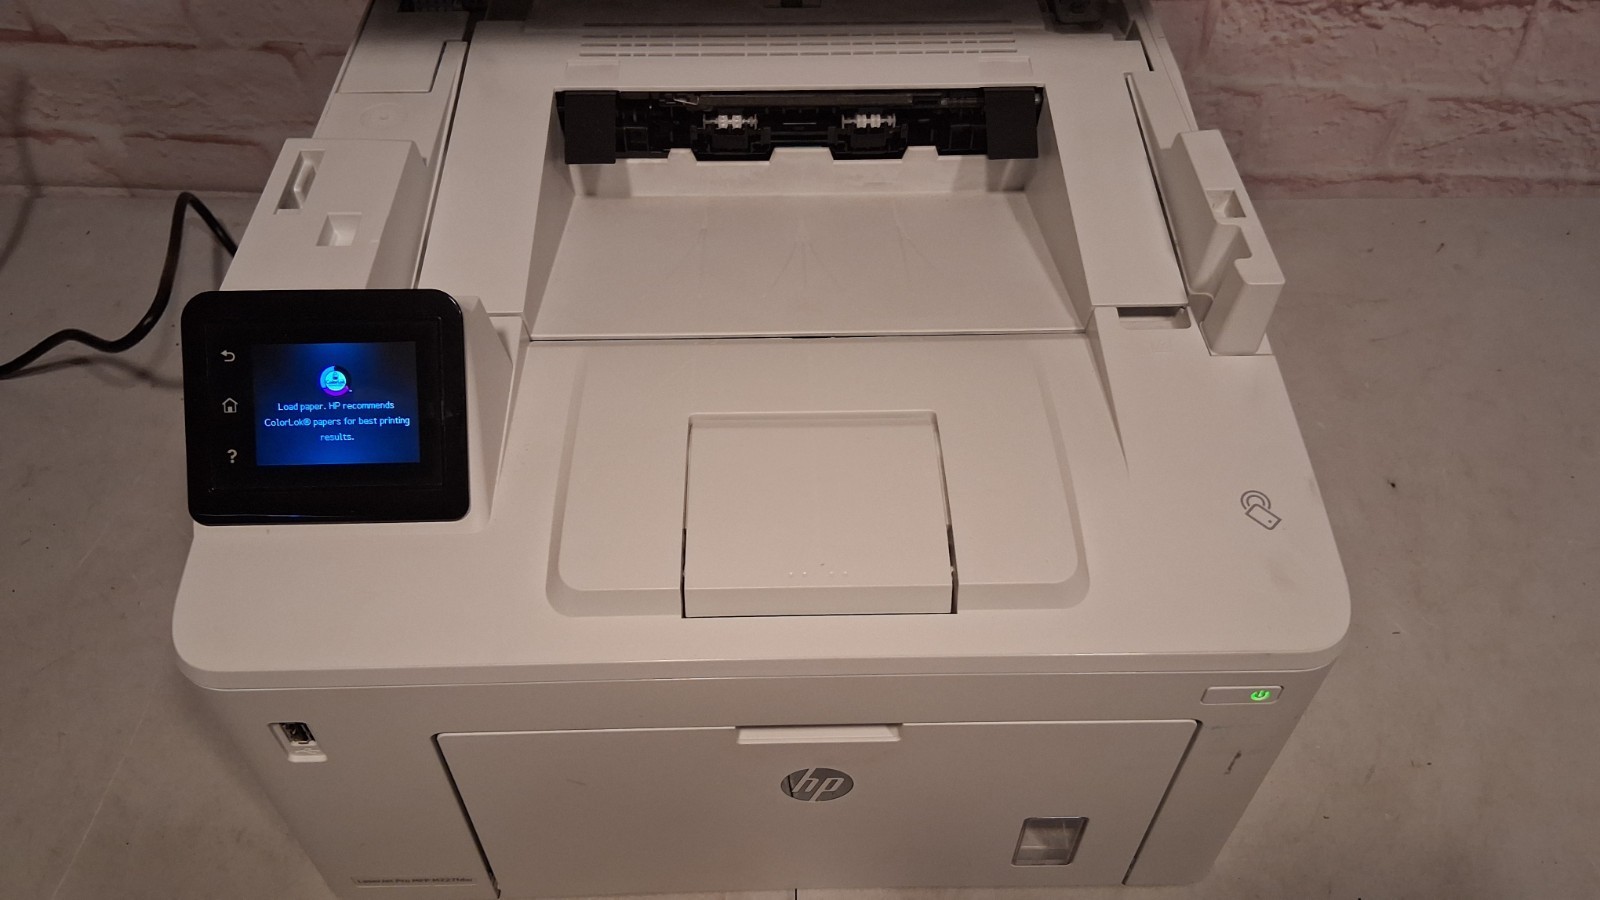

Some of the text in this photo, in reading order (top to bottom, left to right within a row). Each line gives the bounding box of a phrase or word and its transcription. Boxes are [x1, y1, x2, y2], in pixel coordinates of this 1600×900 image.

[277, 401, 395, 413] Load paper. HP recommends
[313, 418, 342, 428] papers
[344, 417, 356, 425] for
[358, 417, 377, 425] best
[379, 416, 410, 427] printing
[320, 433, 355, 441] results.
[791, 767, 845, 802] hp
